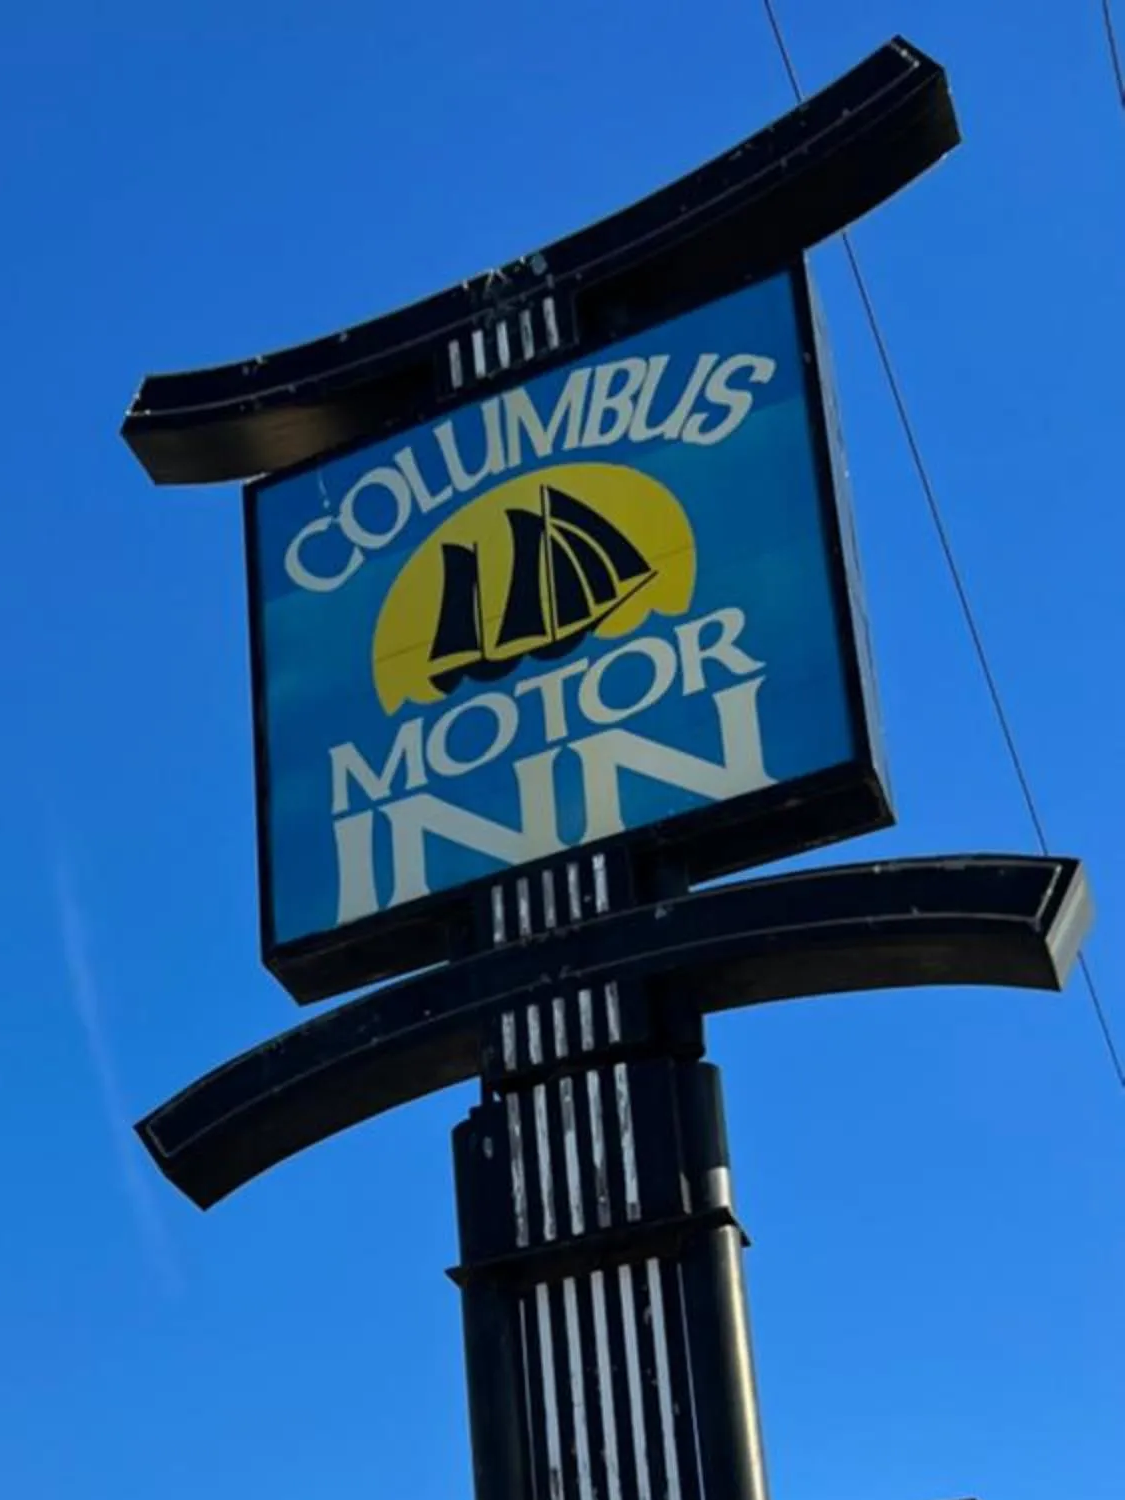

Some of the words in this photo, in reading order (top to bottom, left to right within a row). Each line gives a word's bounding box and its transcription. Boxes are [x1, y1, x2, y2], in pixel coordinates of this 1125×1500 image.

[284, 354, 775, 591] COLUMBUS
[329, 607, 766, 814] MOTOR
[333, 676, 778, 928] INN
